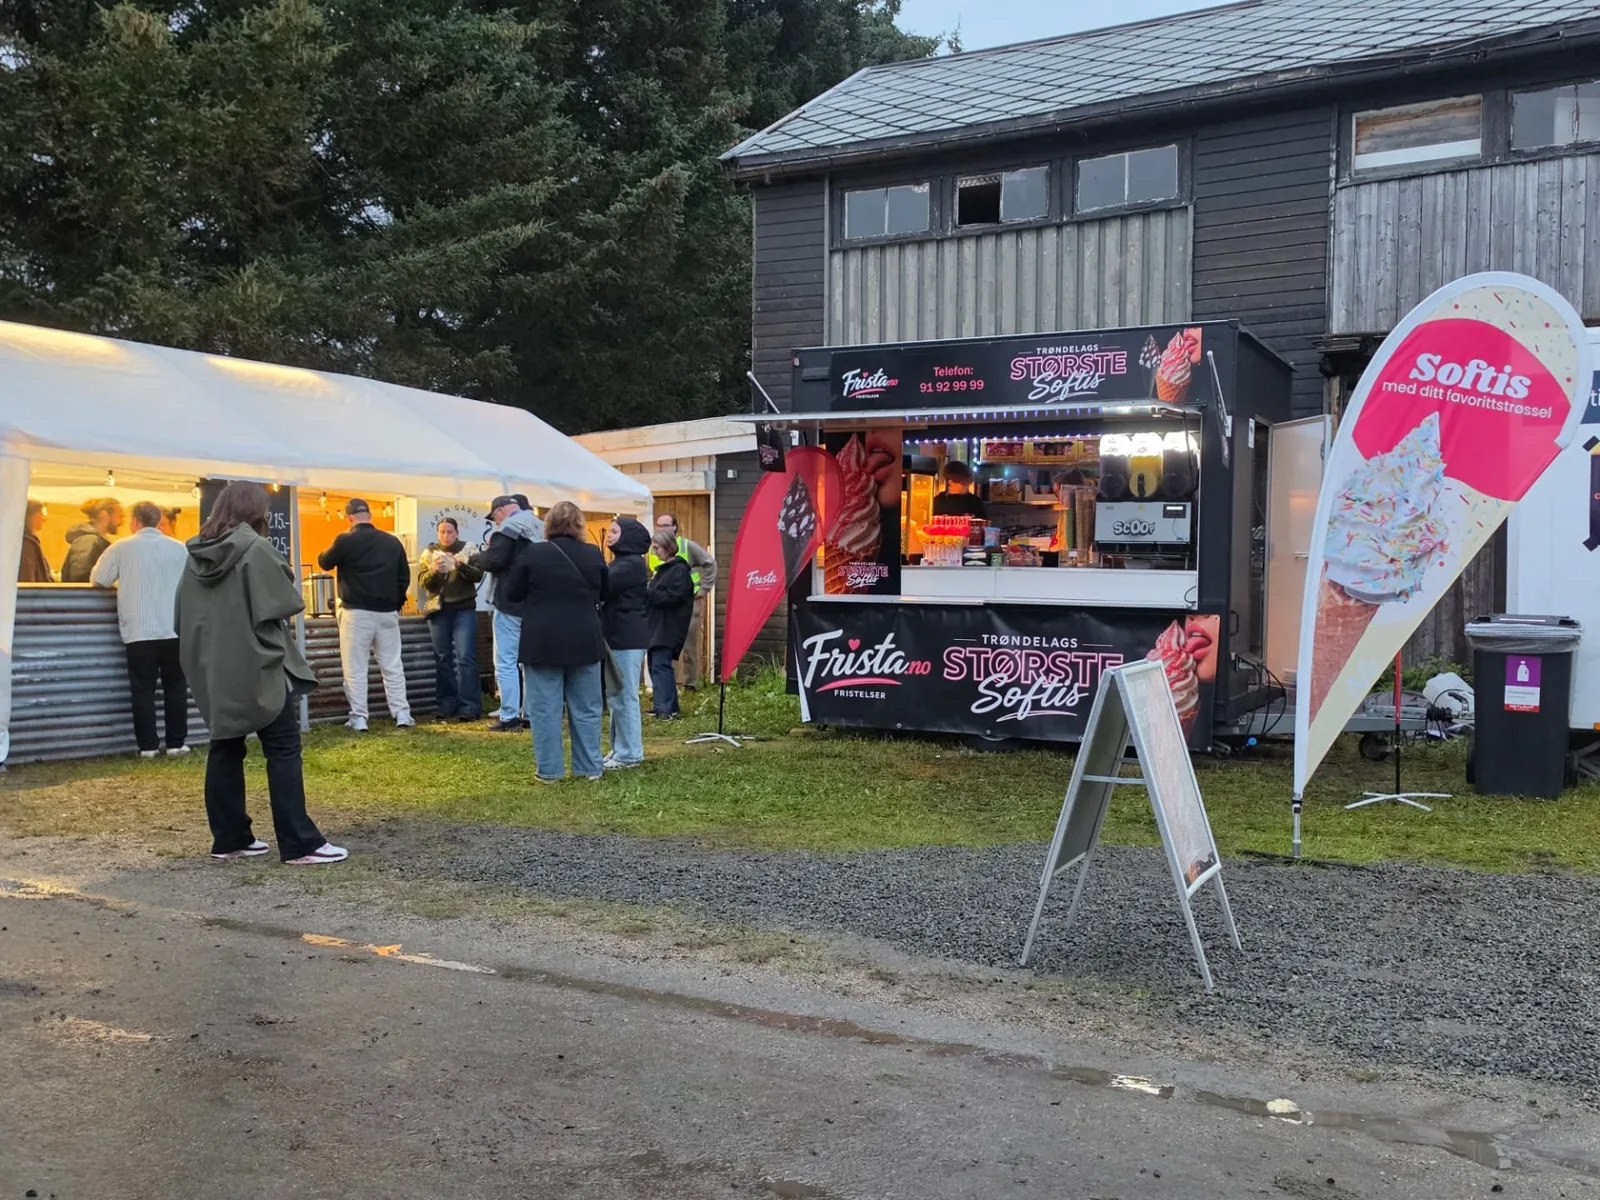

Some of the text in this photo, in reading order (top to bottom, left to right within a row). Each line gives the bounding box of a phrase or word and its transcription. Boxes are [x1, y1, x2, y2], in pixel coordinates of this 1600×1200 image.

[1036, 344, 1098, 355] TRØNDELAGS
[933, 366, 974, 377] Telefon:
[1010, 351, 1127, 380] STØRSTE
[1409, 353, 1532, 399] Softis
[919, 379, 985, 393] 91 92 99 99
[1028, 371, 1105, 400] Softis
[1382, 381, 1552, 419] med ditt favorittstrøssel
[982, 634, 1078, 648] TRØNDELAGS
[834, 689, 886, 699] FRISTELSER
[970, 673, 1089, 720] Softis
